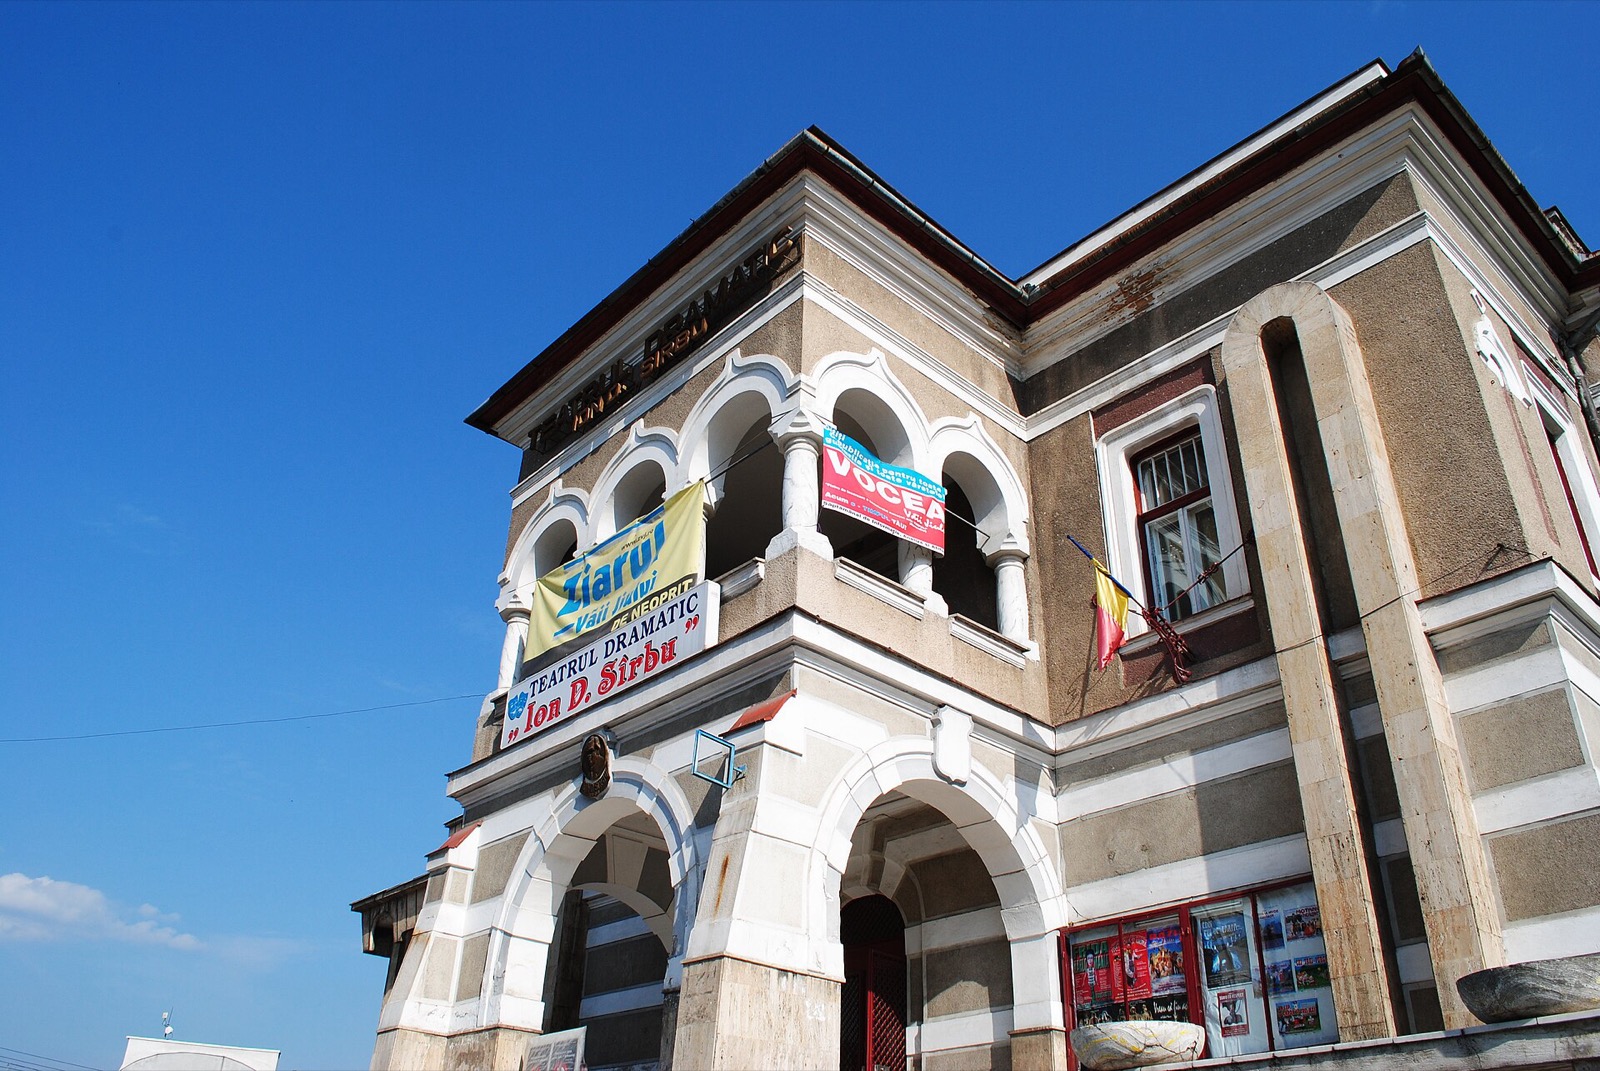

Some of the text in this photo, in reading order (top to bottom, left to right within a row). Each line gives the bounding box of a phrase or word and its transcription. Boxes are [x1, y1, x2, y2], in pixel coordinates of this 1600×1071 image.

[826, 448, 945, 525] VOCEA
[556, 519, 667, 620] Ziarul
[630, 578, 695, 623] NEOPRIT
[529, 592, 699, 699] TEATRUL DRAMATIC
[574, 608, 609, 634] Văii
[567, 664, 592, 712] D.
[597, 637, 679, 707] Sîrbu
